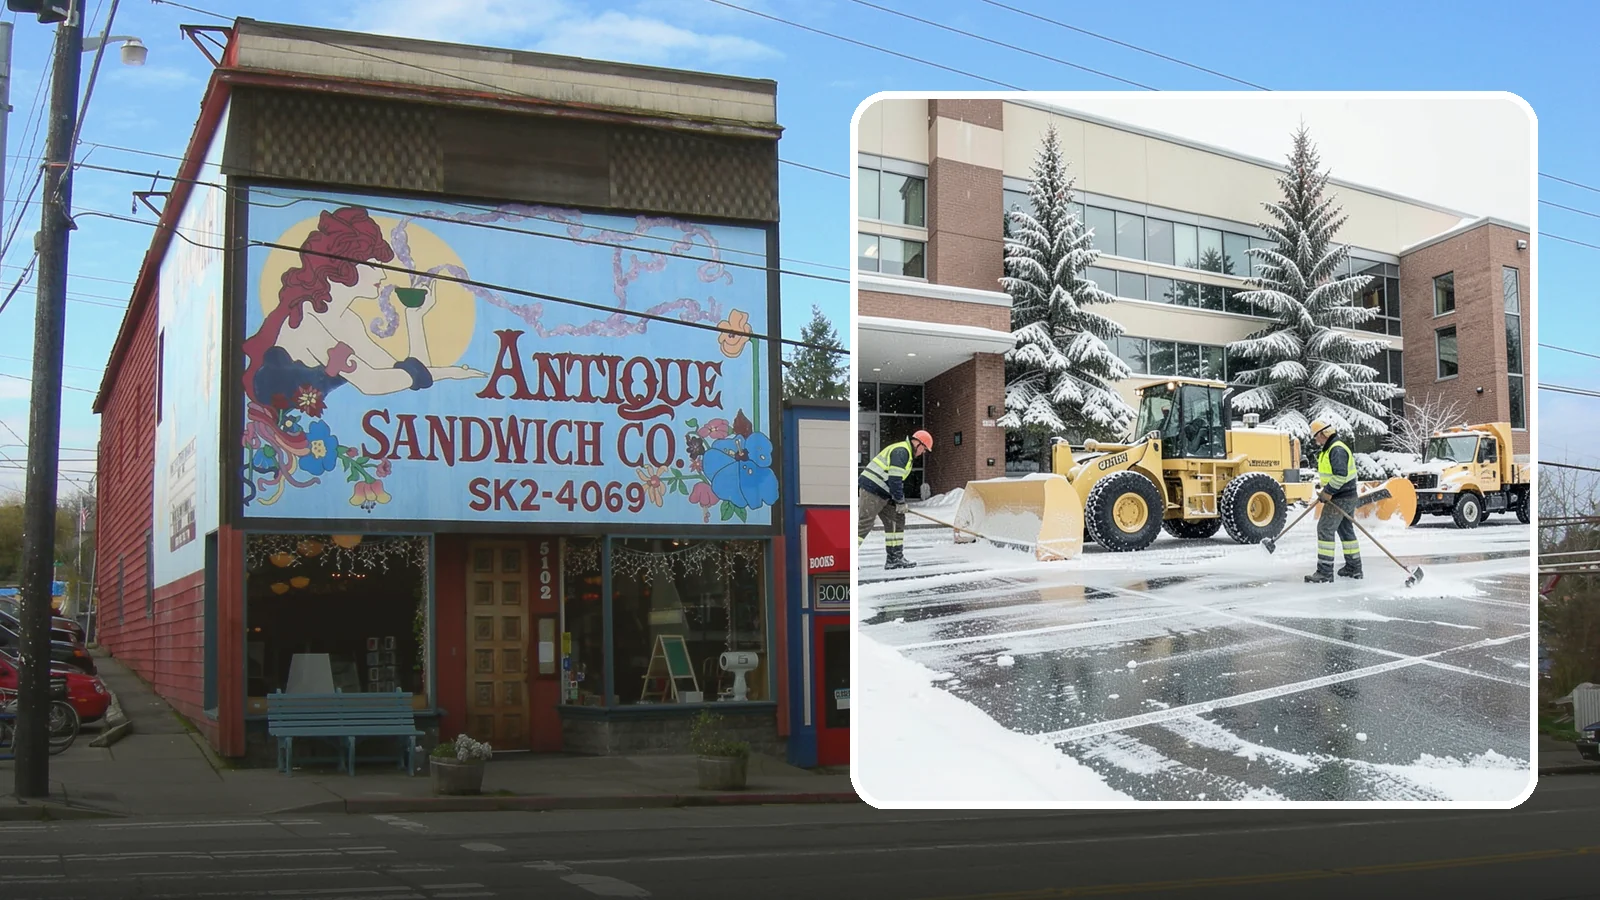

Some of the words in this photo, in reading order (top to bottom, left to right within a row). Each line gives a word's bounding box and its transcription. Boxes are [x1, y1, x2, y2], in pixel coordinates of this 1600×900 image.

[475, 329, 723, 421] ANTIQUE
[361, 408, 604, 467] SANDWICH
[617, 421, 685, 469] CO.
[468, 477, 646, 513] SK2-4069
[539, 541, 552, 600] 5102
[809, 555, 835, 569] BOOKS
